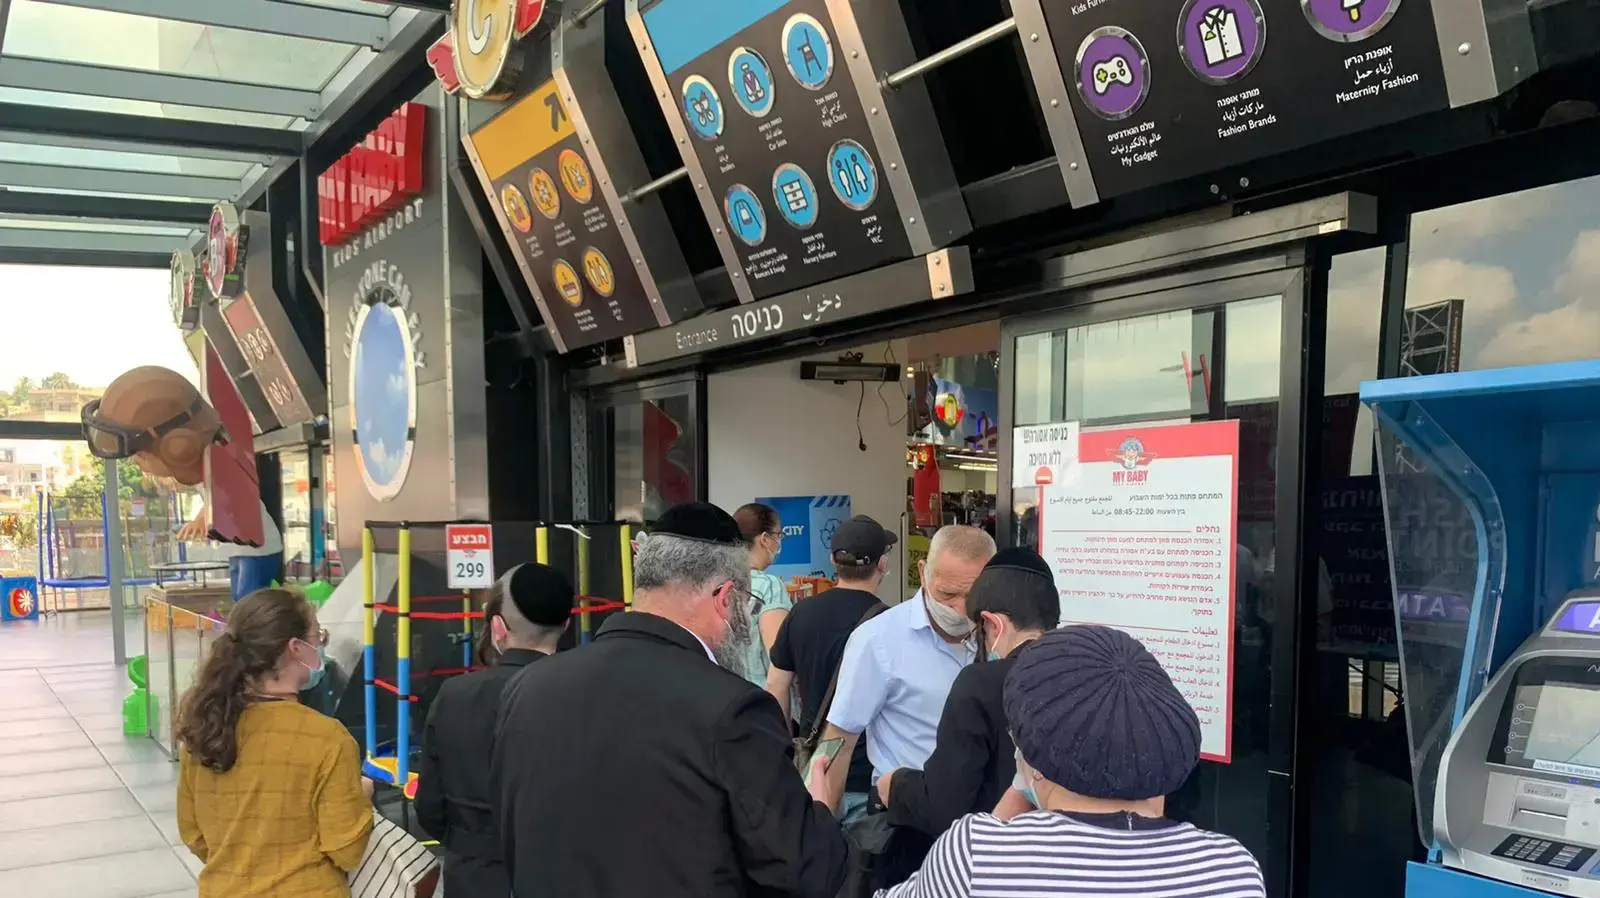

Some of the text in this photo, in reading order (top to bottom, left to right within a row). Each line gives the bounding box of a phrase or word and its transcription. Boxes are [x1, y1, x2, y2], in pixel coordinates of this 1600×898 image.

[1365, 45, 1393, 61] אופנת
[1354, 70, 1373, 85] حمل
[1335, 73, 1419, 104] Maternity Fashion
[1217, 114, 1277, 138] Fashion Brands
[1121, 150, 1158, 167] My Gadget
[364, 198, 424, 250] AIRPORT
[802, 293, 842, 322] دخول
[731, 303, 784, 339] כניסה
[675, 327, 719, 350] Entrance
[1049, 427, 1068, 441] כניסה
[1048, 449, 1061, 465] ללא
[1112, 470, 1149, 484] MY BABY
[1129, 494, 1149, 502] השבוע
[1165, 493, 1179, 501] בכל
[1180, 493, 1197, 501] פתוח
[1198, 492, 1224, 500] המתחם
[1113, 508, 1155, 516] 08:45-22:00
[1177, 508, 1186, 516] בין
[782, 525, 804, 536] CITY
[1196, 525, 1220, 534] נהלים
[452, 533, 488, 545] מבצע
[1167, 548, 1189, 556] למתחם
[1190, 549, 1214, 557] הכניסה
[1166, 559, 1189, 567] למתחם
[456, 562, 485, 578] 299
[1177, 595, 1198, 603] הנושא
[1199, 596, 1213, 604] אדם
[1192, 626, 1218, 637] تعليمات
